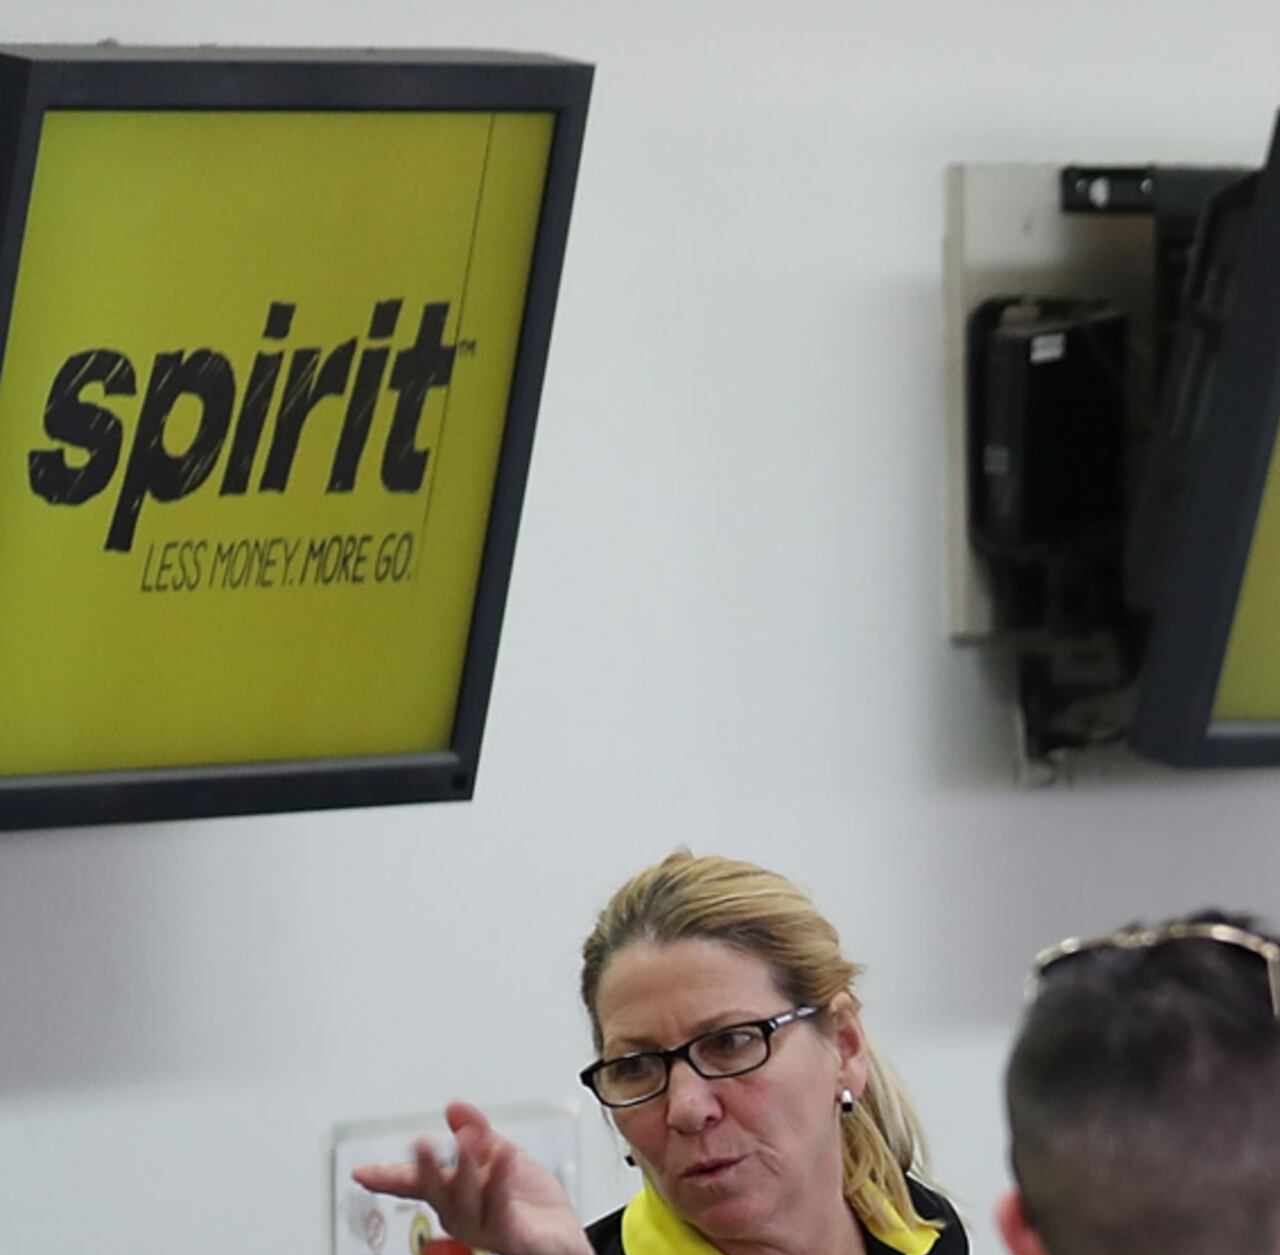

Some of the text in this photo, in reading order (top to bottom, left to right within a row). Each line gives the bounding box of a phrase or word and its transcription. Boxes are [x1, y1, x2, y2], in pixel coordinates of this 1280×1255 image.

[28, 298, 457, 552] spirit
[141, 538, 207, 592] LESS
[209, 536, 299, 590] MONEY.
[300, 534, 367, 585] MORE
